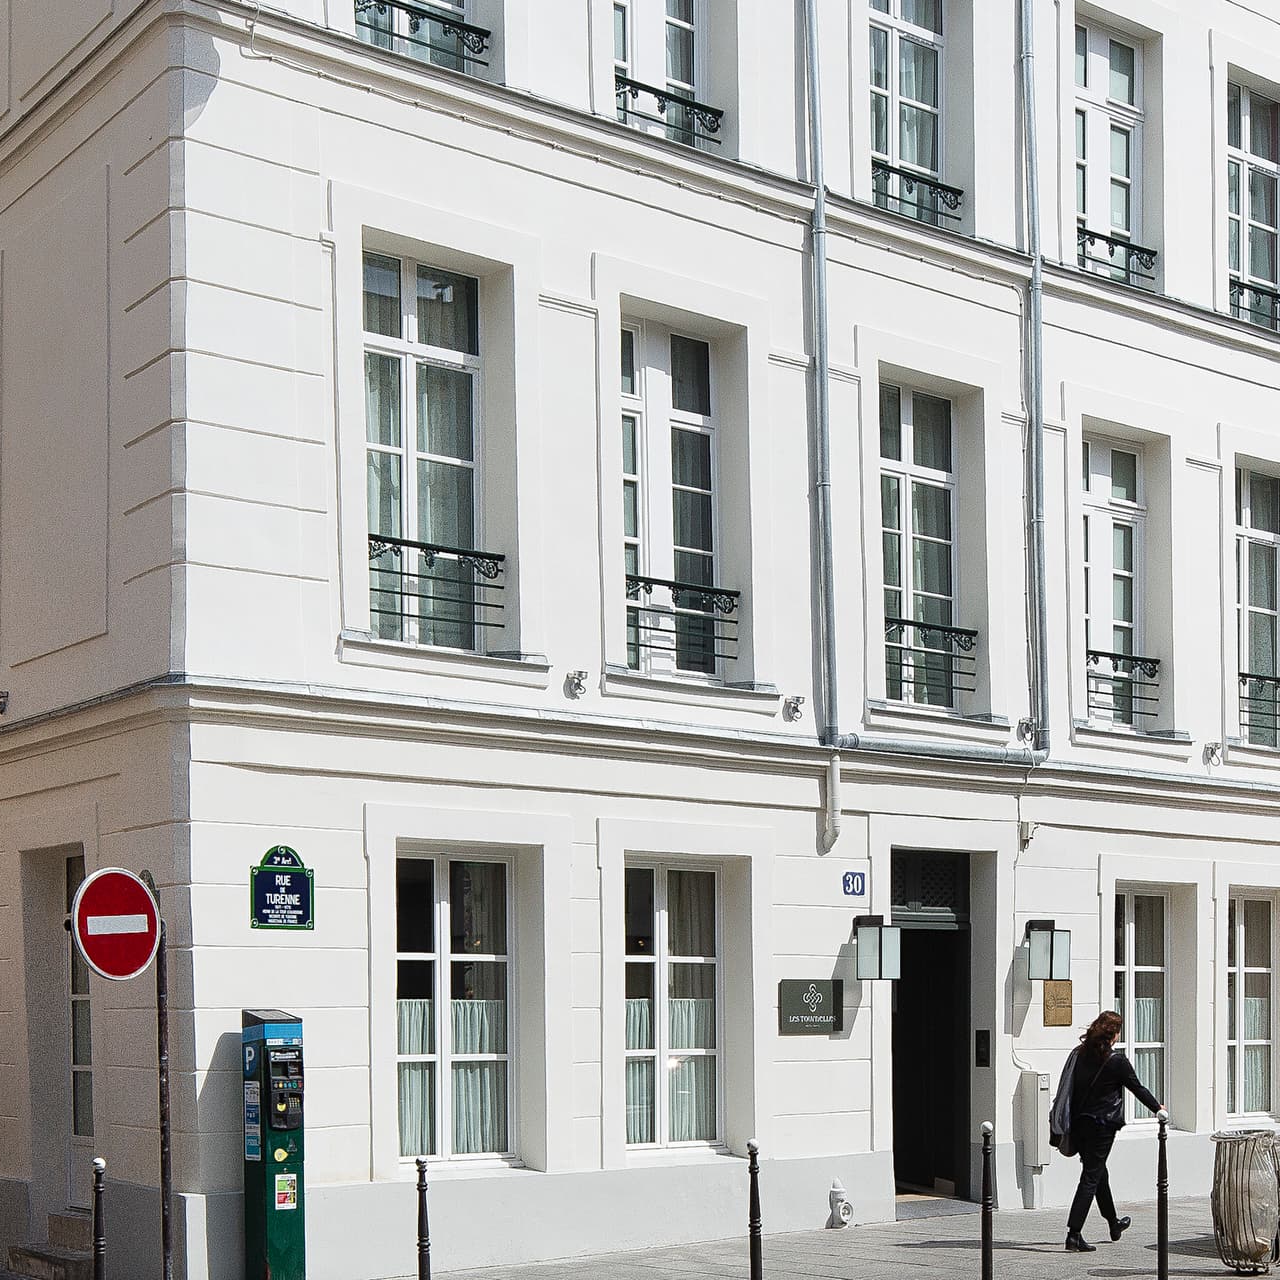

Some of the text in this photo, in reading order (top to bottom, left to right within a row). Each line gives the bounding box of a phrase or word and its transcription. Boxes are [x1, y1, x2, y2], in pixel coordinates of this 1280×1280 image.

[275, 874, 292, 886] RUE
[845, 874, 862, 893] 30
[265, 893, 301, 905] TURENNE
[245, 1046, 255, 1071] P
